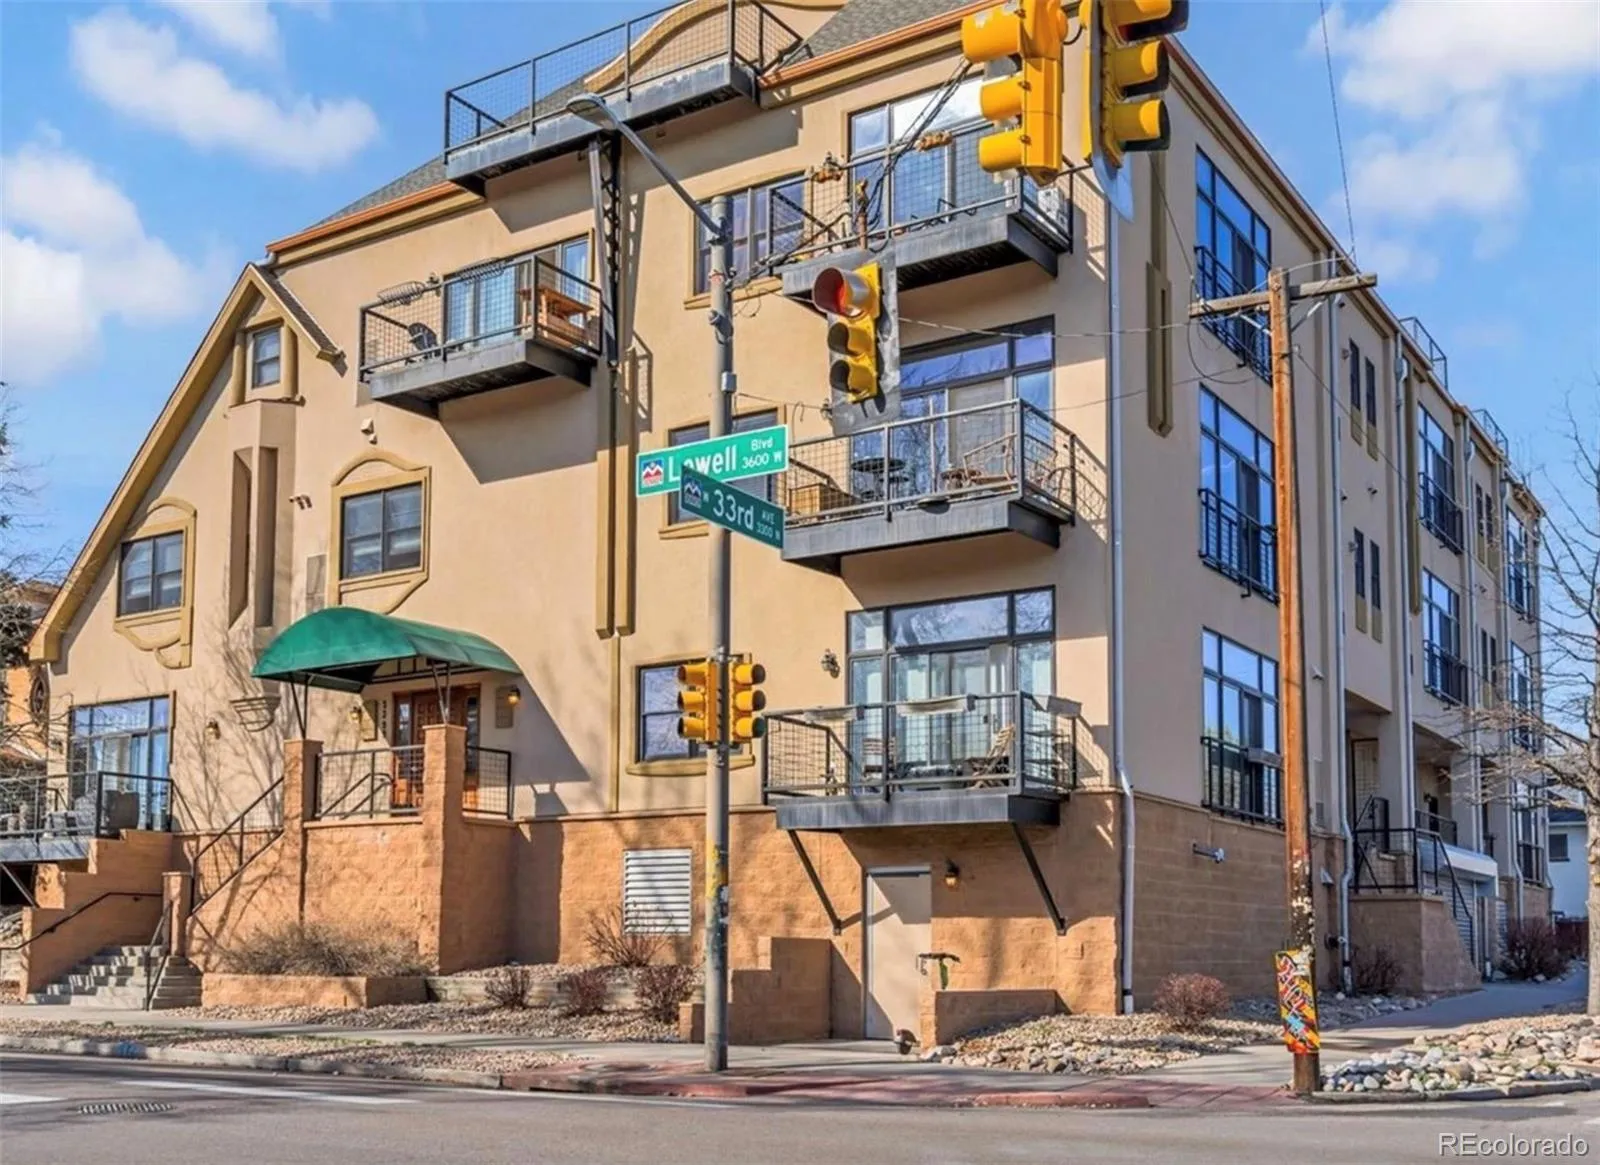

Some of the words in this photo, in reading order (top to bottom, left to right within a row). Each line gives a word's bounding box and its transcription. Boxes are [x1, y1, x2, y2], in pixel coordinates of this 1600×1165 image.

[751, 437, 773, 451] Blvd
[742, 453, 769, 469] 3600
[773, 451, 783, 463] W
[712, 489, 754, 530] 33rd
